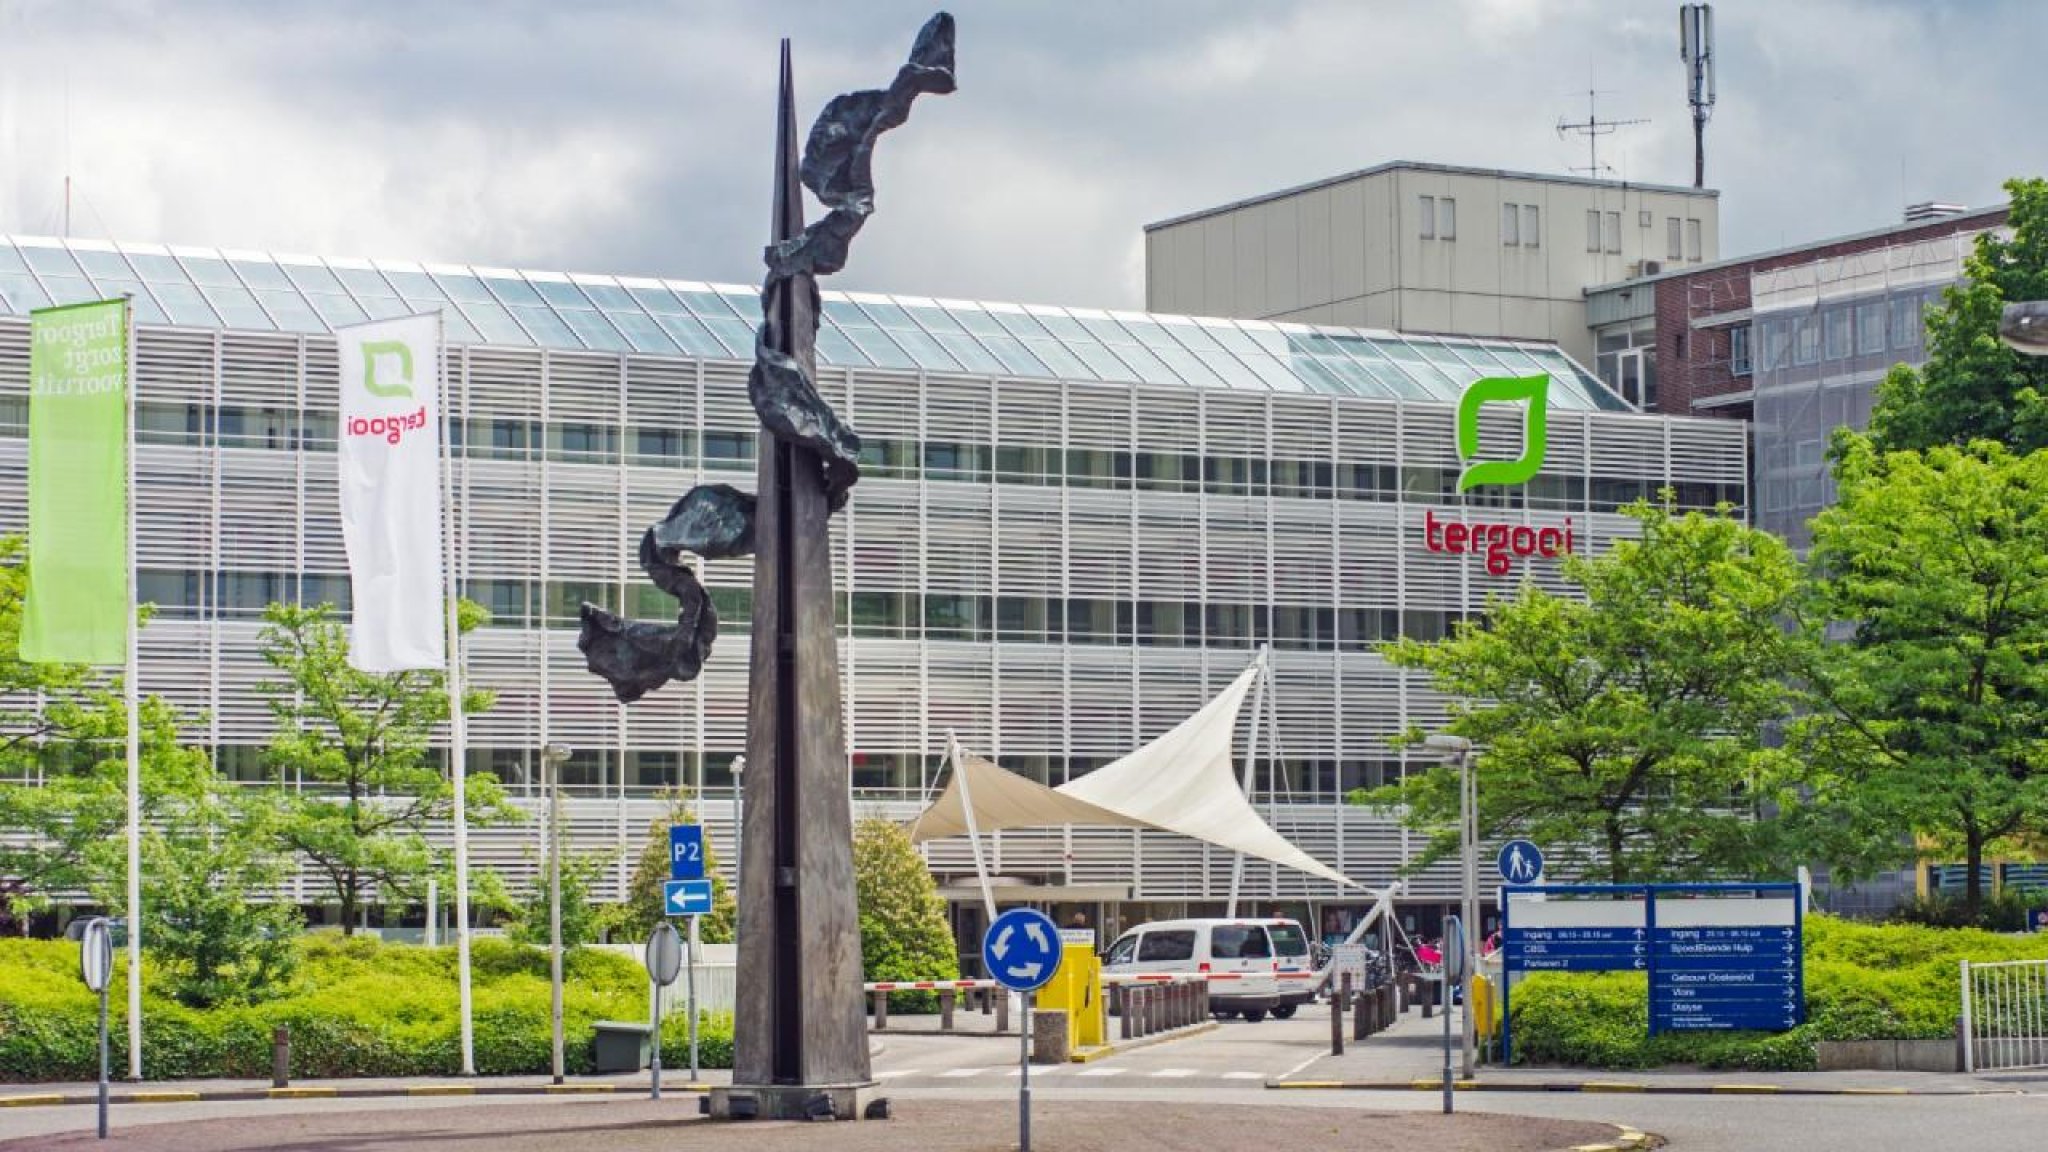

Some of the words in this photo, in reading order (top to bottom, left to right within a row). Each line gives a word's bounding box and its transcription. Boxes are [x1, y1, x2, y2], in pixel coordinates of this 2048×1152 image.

[1425, 508, 1574, 577] tergooi
[674, 843, 701, 862] P2
[1708, 972, 1755, 982] Oostind
